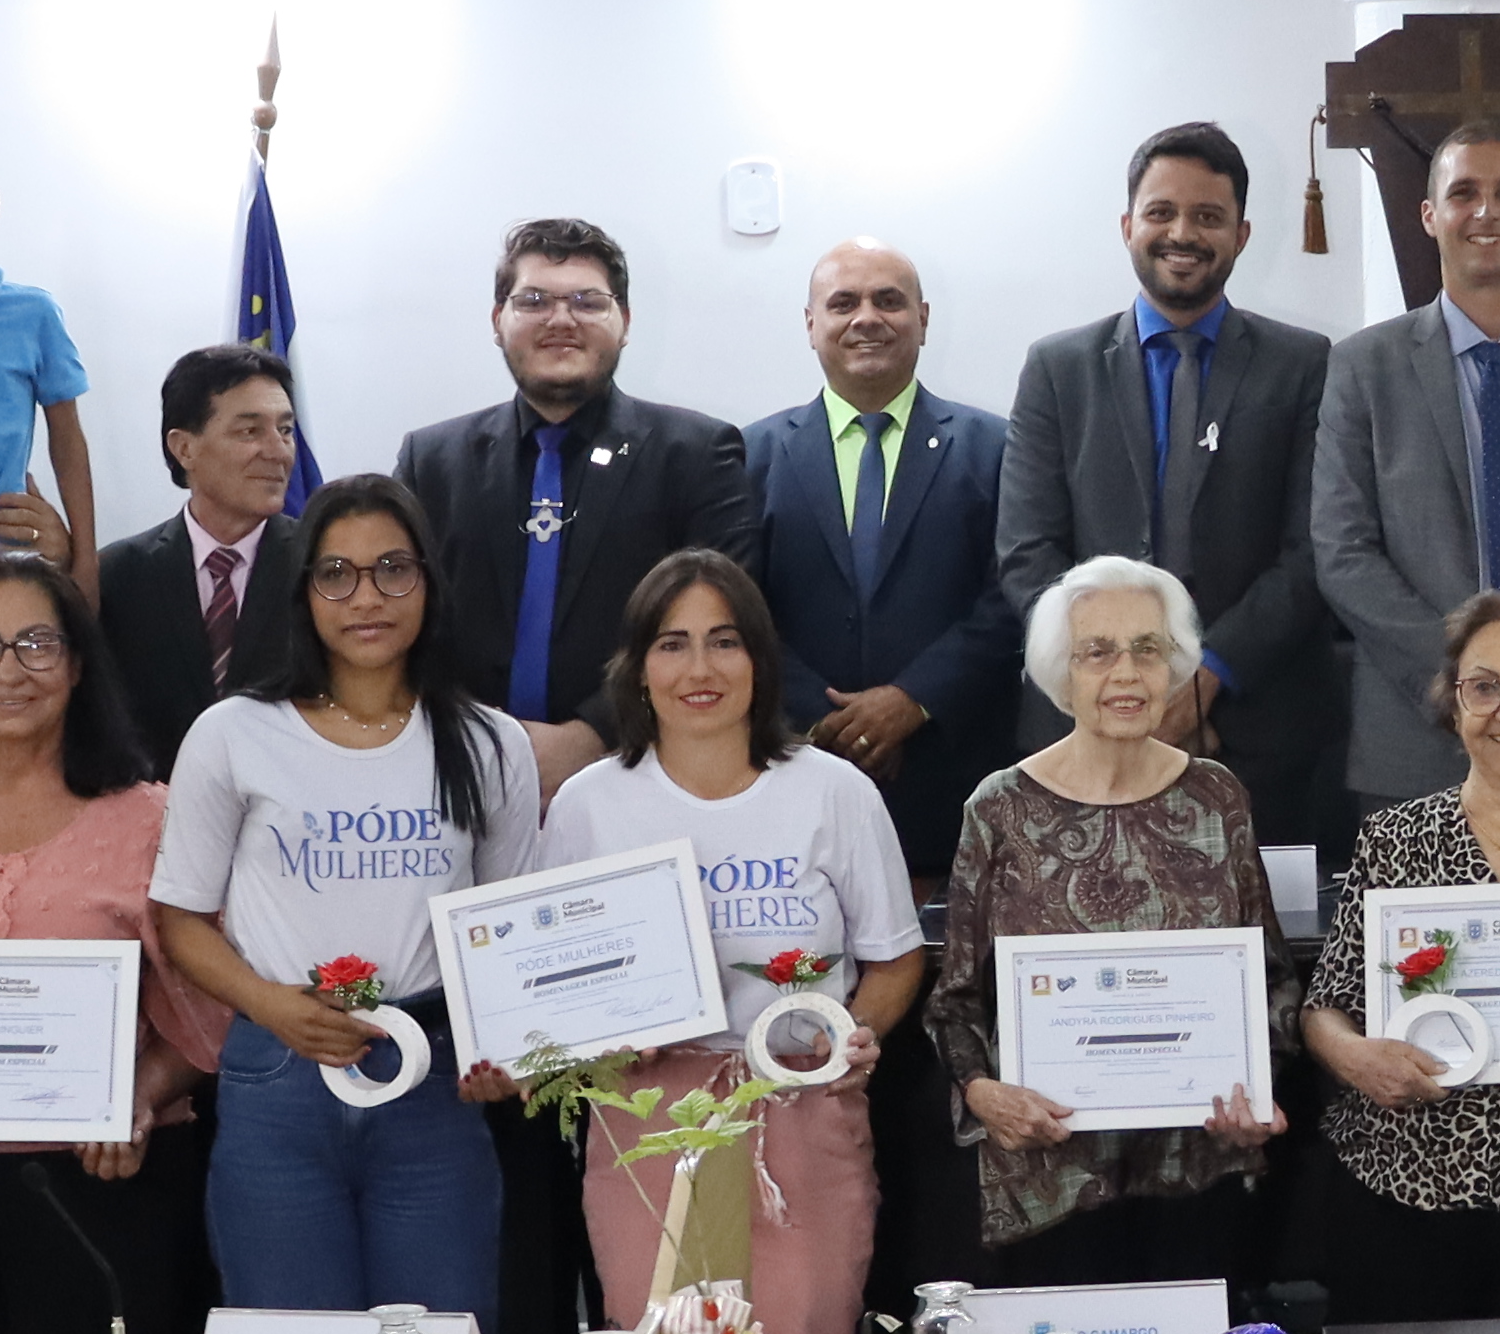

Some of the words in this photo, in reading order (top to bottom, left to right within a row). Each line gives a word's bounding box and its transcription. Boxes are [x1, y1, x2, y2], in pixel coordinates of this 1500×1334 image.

[327, 802, 442, 843] PÓDE
[562, 894, 594, 910] Câmara
[562, 901, 605, 917] Municipal
[709, 896, 819, 930] HERES
[515, 952, 556, 975] PÓDE
[558, 936, 636, 965] MULHERES
[1126, 967, 1158, 977] Câmara
[1126, 975, 1168, 985] Municipal
[1049, 1015, 1098, 1028] JANDYRA
[1100, 1014, 1163, 1026] RODRIGUES
[1164, 1012, 1217, 1023] PINHEIRO
